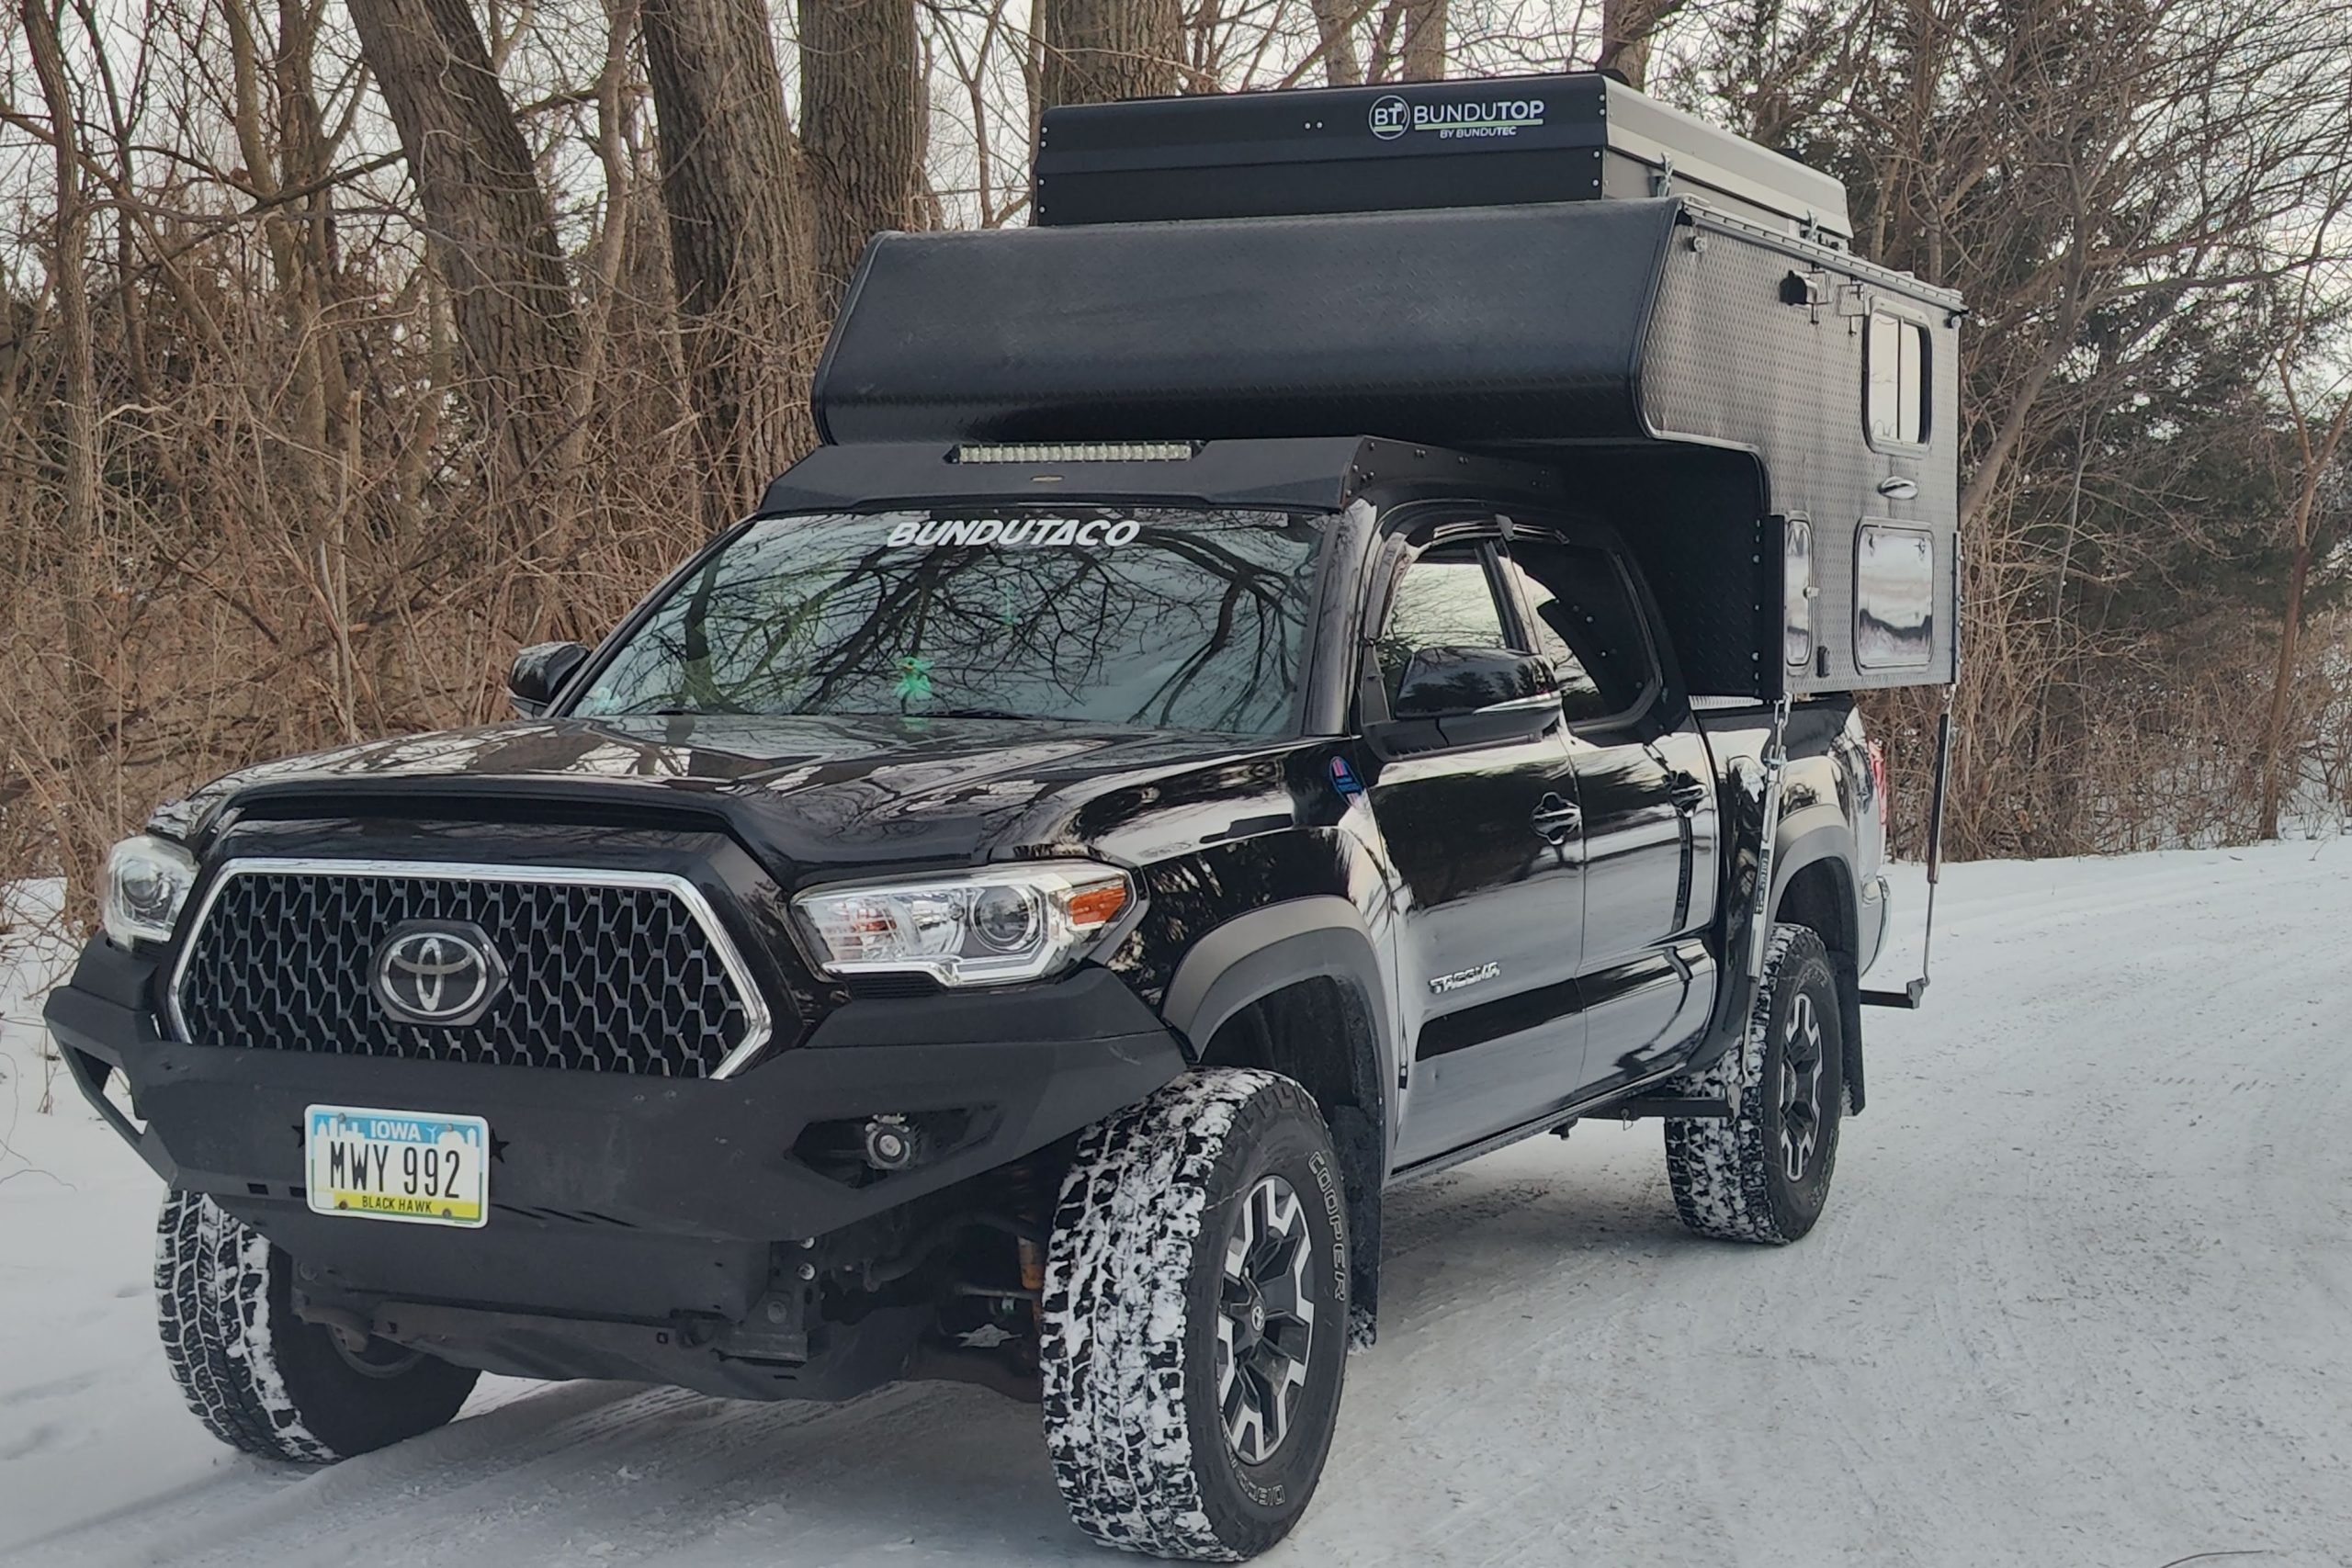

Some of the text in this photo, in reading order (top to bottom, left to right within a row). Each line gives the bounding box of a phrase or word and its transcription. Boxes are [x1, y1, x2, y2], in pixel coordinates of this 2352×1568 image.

[1413, 100, 1544, 124] BUNDUTOP
[1439, 127, 1516, 139] BY BUNDUTEC
[887, 519, 1141, 547] BUNDUTACO
[370, 1120, 422, 1142] IOWA
[330, 1141, 460, 1199] MWY 992
[362, 1195, 433, 1213] BLACK HAWK
[1308, 1151, 1346, 1302] COOPER
